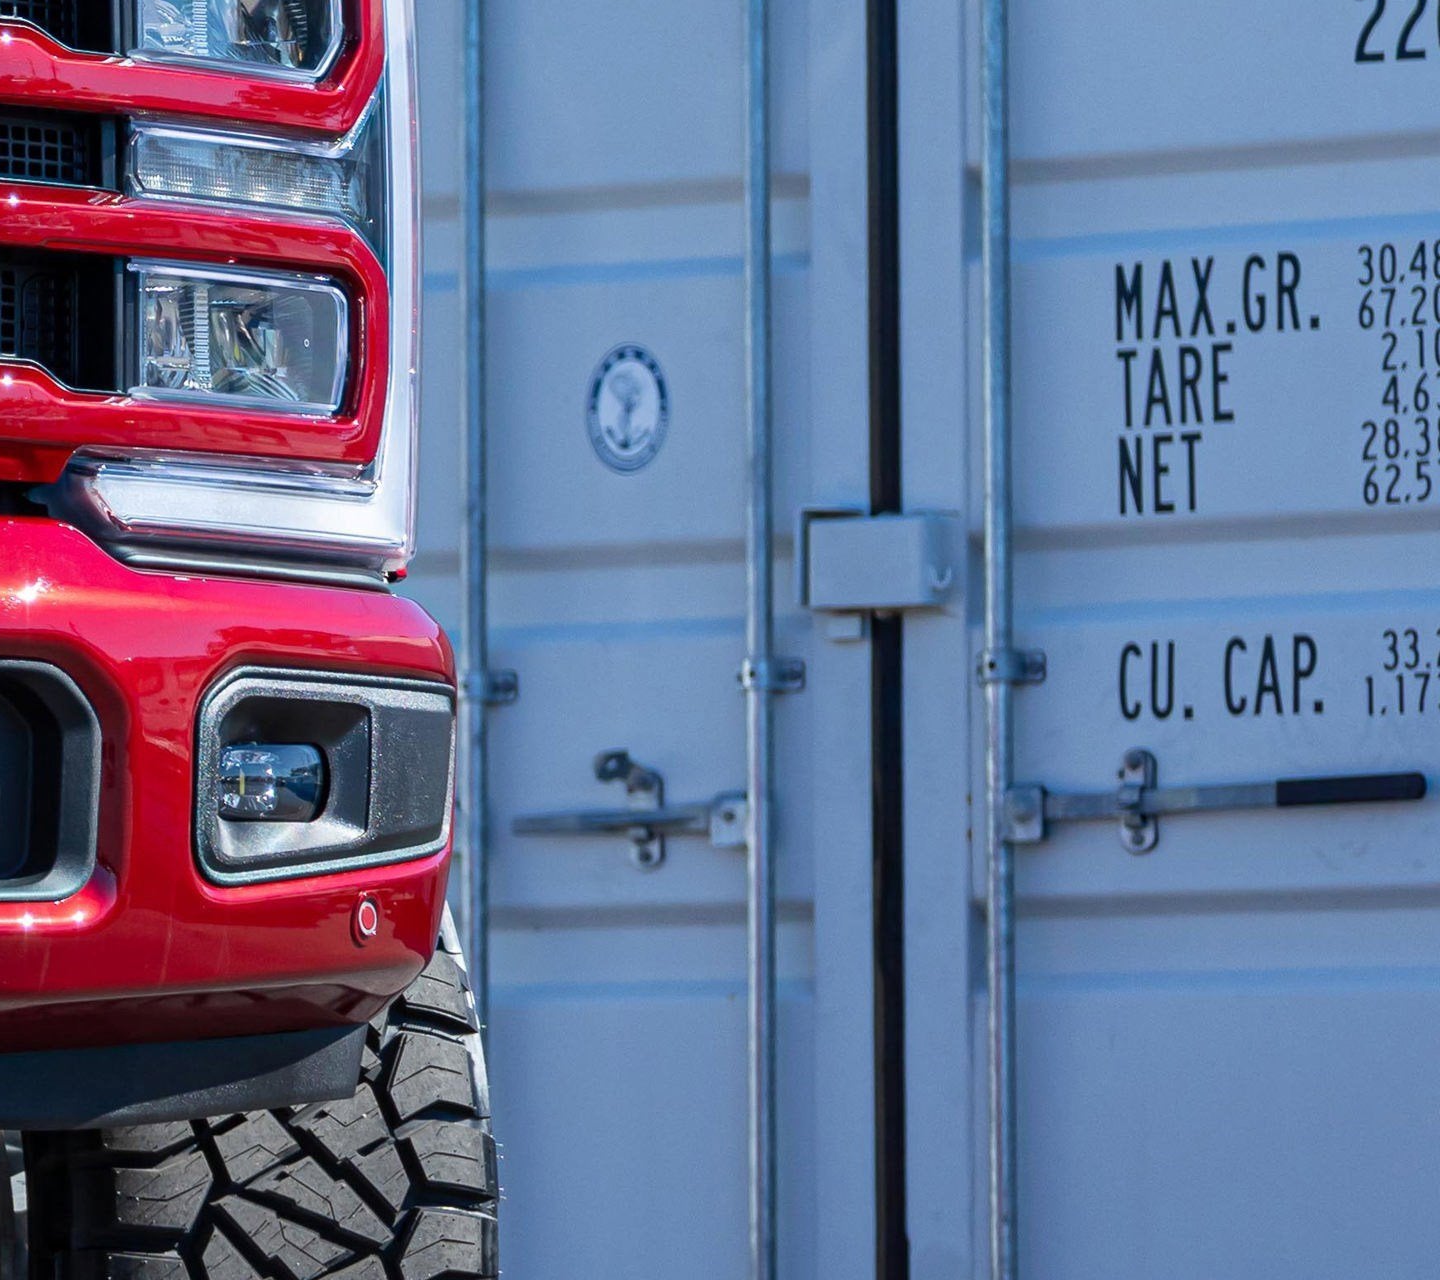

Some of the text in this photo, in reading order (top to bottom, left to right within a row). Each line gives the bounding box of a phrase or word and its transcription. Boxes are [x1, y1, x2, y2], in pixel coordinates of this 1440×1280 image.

[1115, 250, 1320, 341] MAX.GR.
[1116, 342, 1235, 428] TARE
[1118, 431, 1202, 515] NET
[1119, 633, 1324, 721] CU. CAP.
[1383, 627, 1440, 671] 33.
